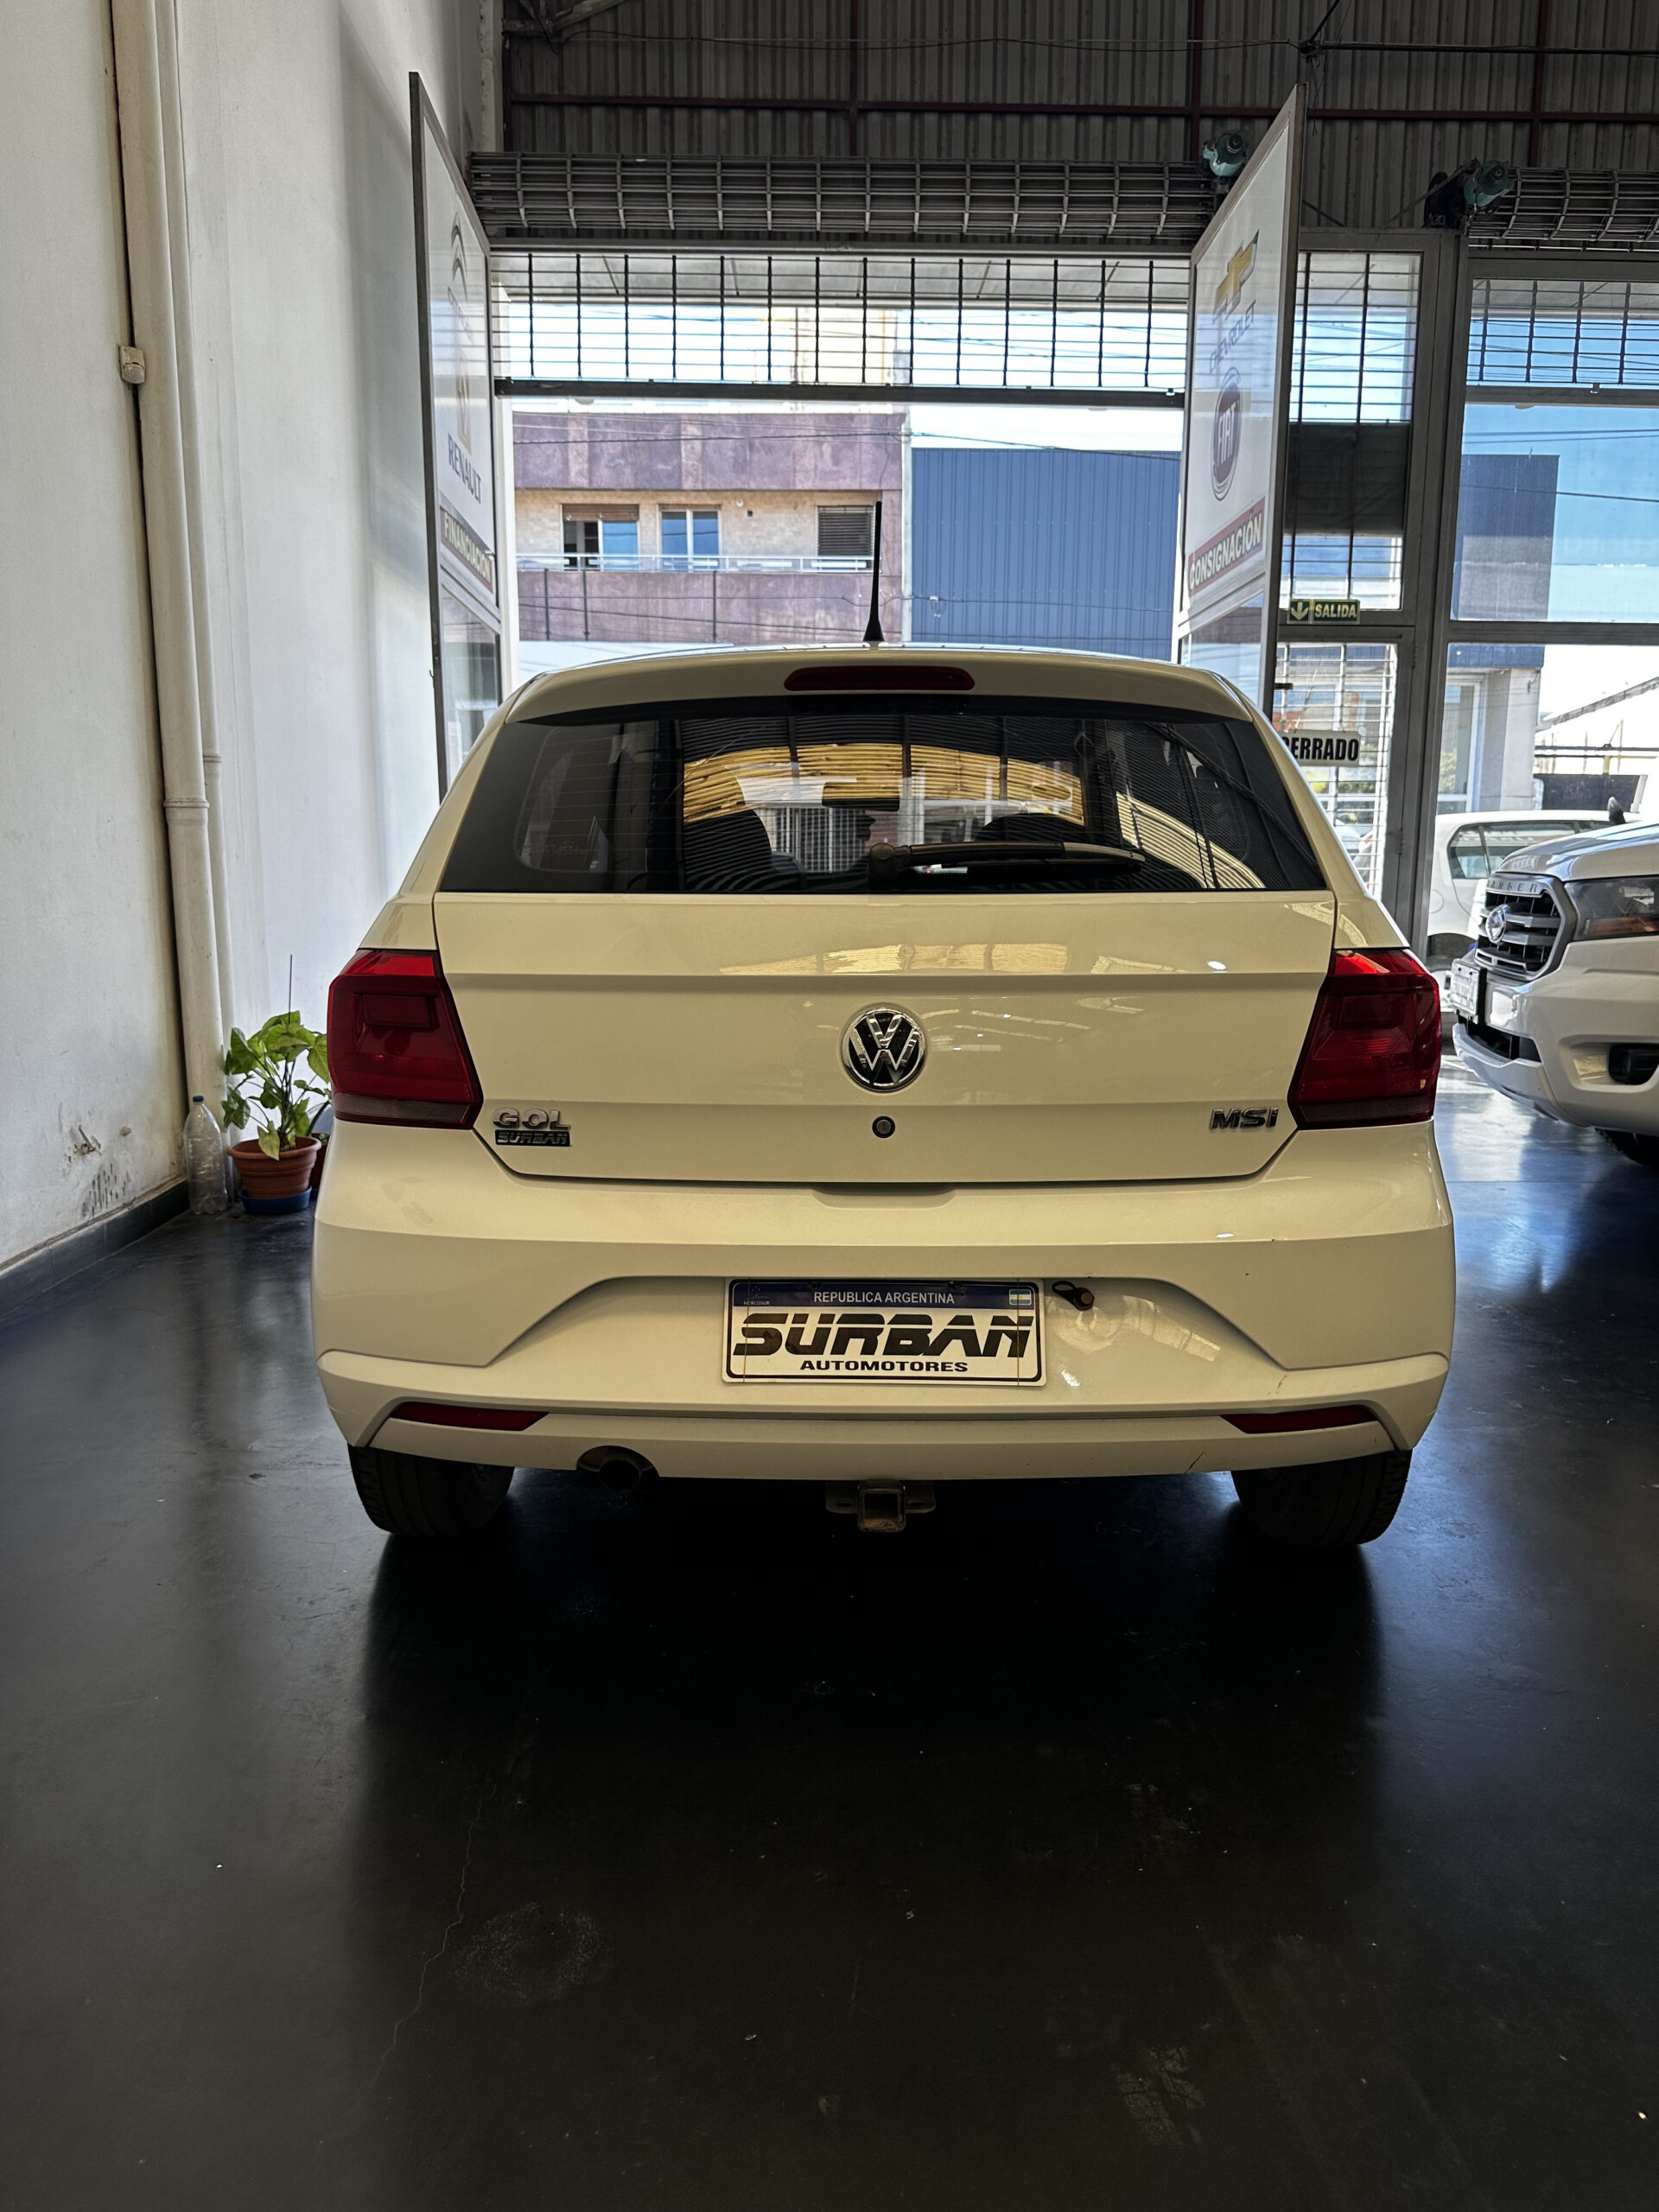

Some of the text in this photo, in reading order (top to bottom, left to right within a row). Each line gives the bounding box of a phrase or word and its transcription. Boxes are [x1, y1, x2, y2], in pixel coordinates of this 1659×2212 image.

[1217, 400, 1236, 468] FIAT
[448, 433, 482, 505] RENAULT
[1189, 512, 1262, 591] CONSIGNACIÓN
[1314, 603, 1357, 618] SALIDA
[492, 1108, 571, 1130] GOL
[497, 1132, 569, 1145] SURBAN
[814, 1292, 955, 1304] REPUBLICA ARGENTINA
[733, 1313, 1034, 1357] SURBAN
[799, 1360, 969, 1372] AUTOMOTORES
